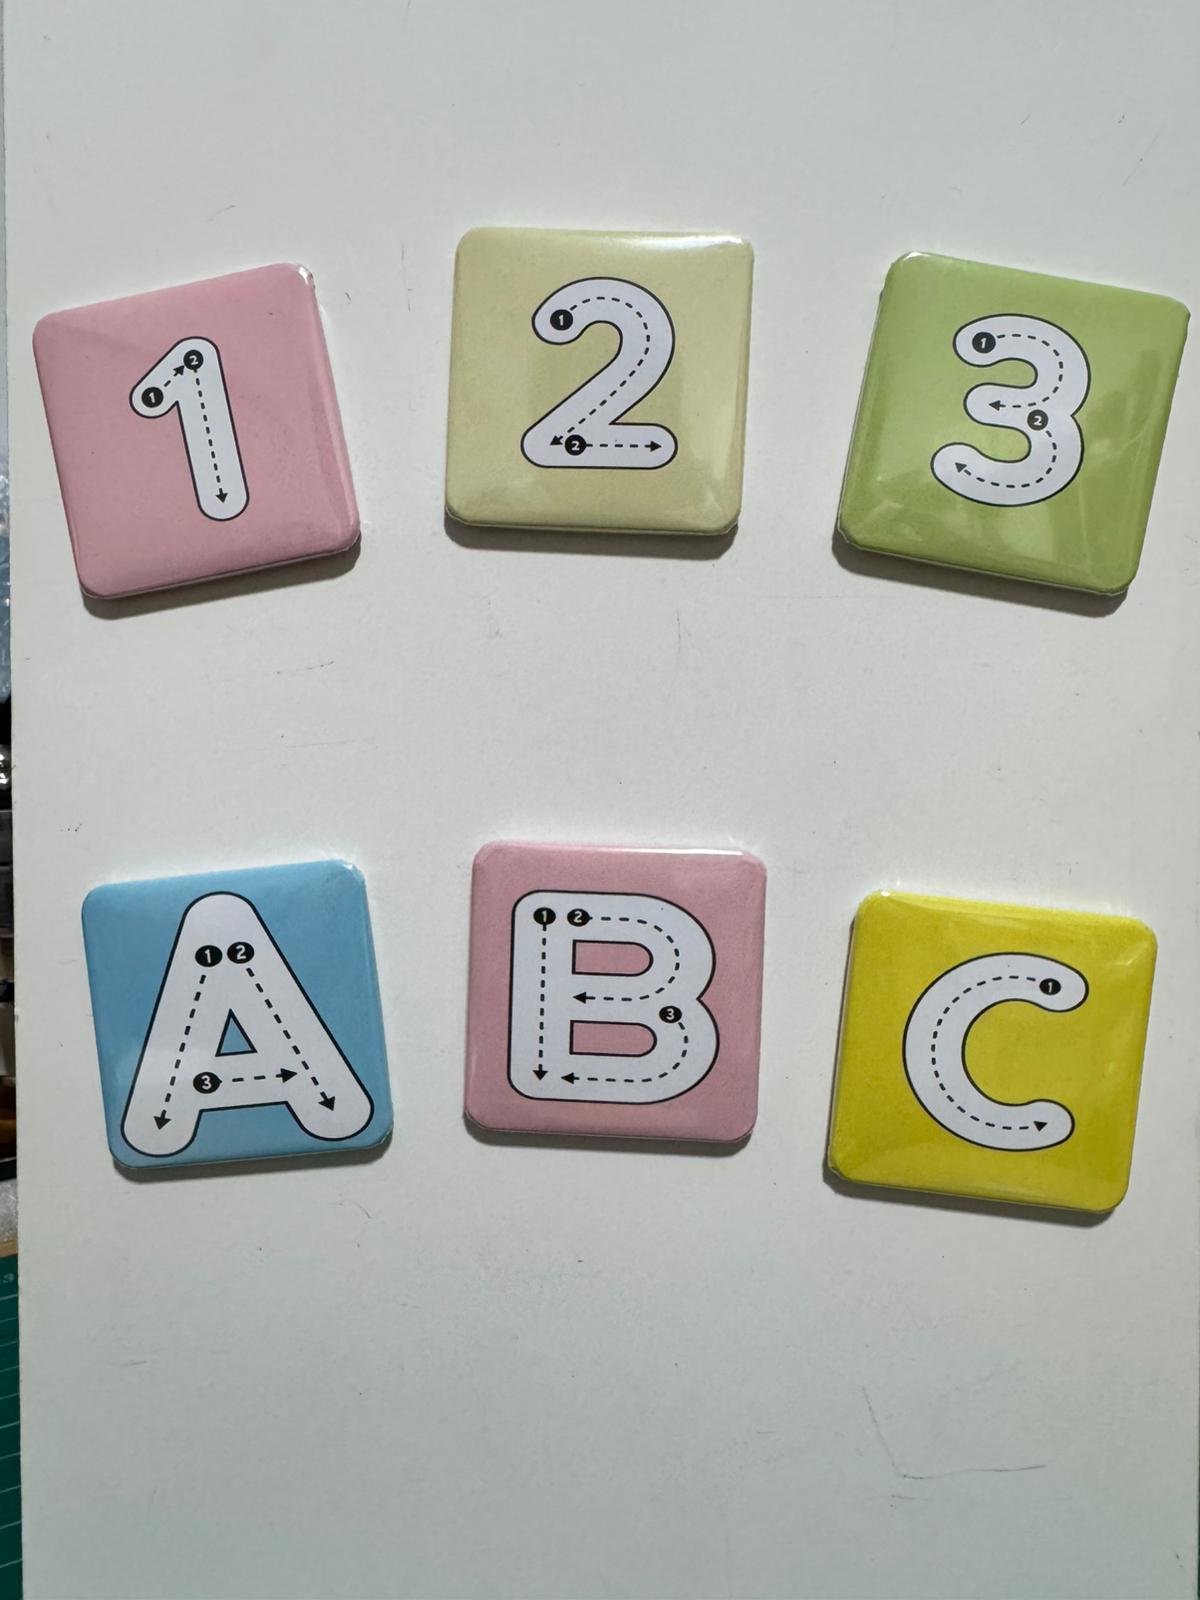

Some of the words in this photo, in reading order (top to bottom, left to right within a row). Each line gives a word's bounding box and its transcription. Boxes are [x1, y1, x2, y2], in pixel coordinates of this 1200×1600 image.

[129, 336, 250, 522] 1
[521, 276, 679, 471] 2
[930, 313, 1092, 508] 3
[120, 890, 375, 1158] A
[507, 889, 721, 1105] B
[901, 951, 1090, 1152] C
